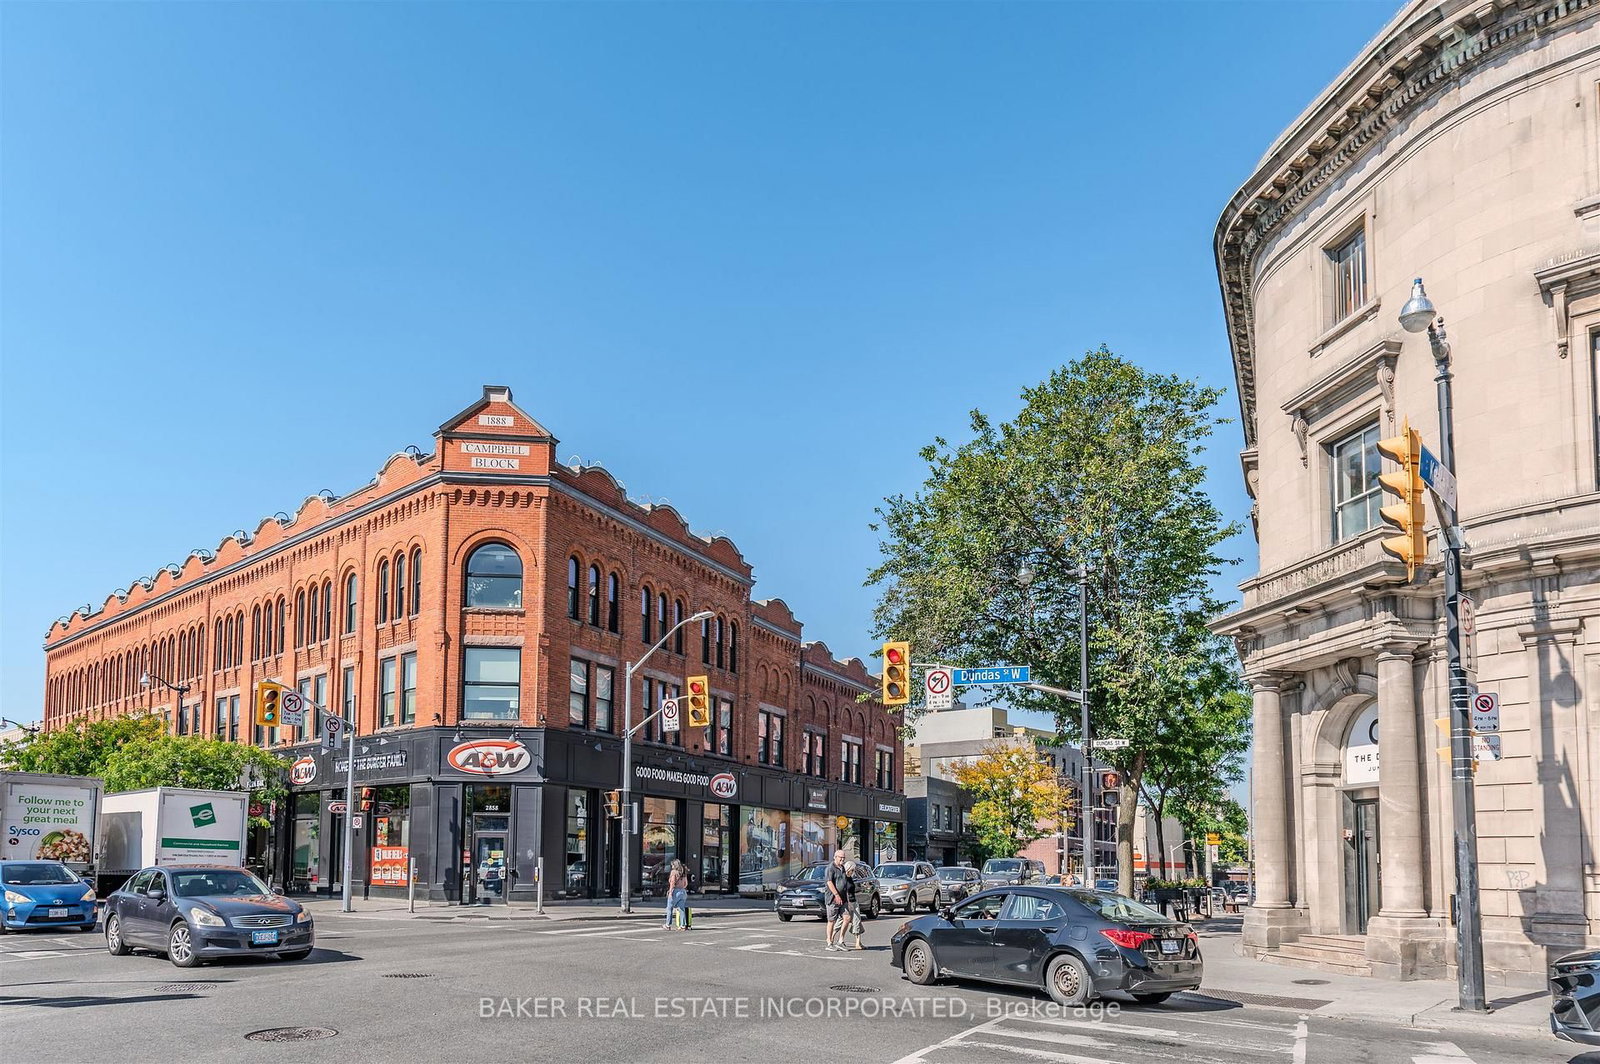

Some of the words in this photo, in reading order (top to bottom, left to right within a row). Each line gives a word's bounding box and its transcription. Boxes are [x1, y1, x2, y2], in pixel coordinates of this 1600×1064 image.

[487, 416, 506, 425] 1888
[466, 444, 524, 454] CAMPBELL
[476, 458, 515, 468] BLOCK
[961, 670, 1000, 681] Dundas
[1011, 669, 1020, 679] W
[367, 756, 387, 769] BURGER
[387, 753, 407, 767] FAMILY
[460, 751, 526, 768] A&W
[1355, 754, 1371, 763] THE
[636, 766, 651, 778] GOOD
[652, 768, 666, 780] FOOD
[666, 770, 682, 782] MAKES
[683, 773, 696, 784] GOOD
[697, 775, 709, 786] FOOD
[715, 782, 735, 794] A&W
[18, 796, 52, 805] Follow
[27, 806, 51, 815] your
[23, 815, 50, 824] great
[9, 826, 40, 837] Sysco
